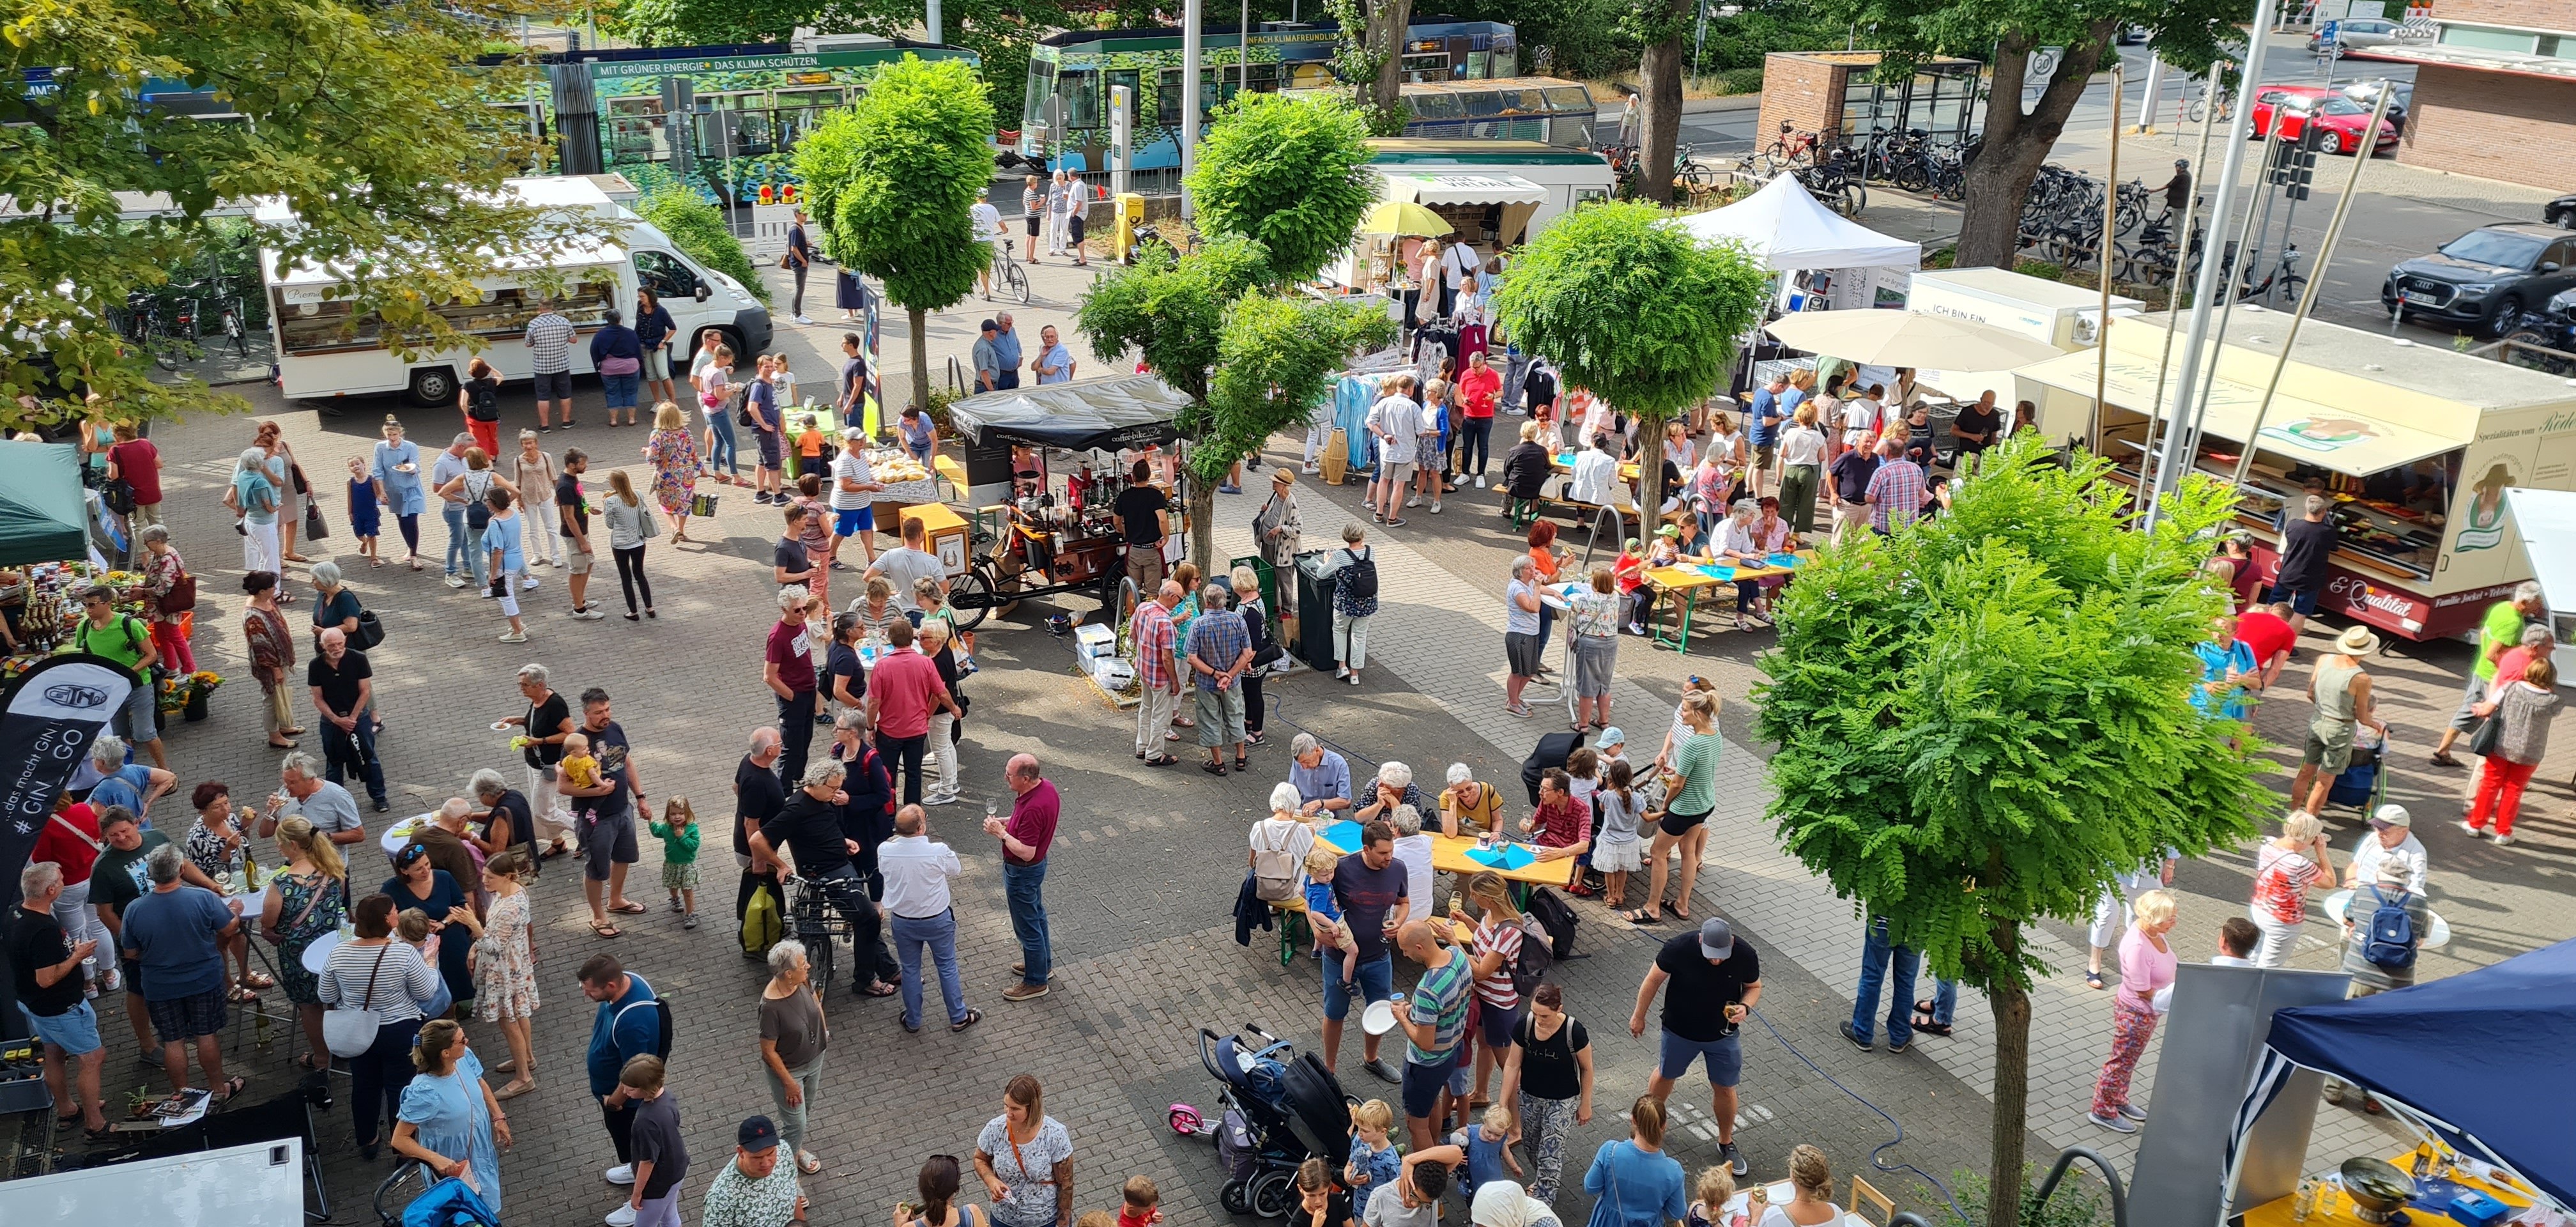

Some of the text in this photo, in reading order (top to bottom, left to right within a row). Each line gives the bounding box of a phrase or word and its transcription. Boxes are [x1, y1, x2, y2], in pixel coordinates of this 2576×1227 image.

[1246, 35, 1273, 44] INFACH
[600, 66, 618, 75] MIT
[621, 63, 662, 74] GRÜNER
[715, 61, 734, 70] DAS
[737, 59, 766, 68] KLIMA
[769, 57, 820, 67] SCHÜTZEN.
[2037, 58, 2050, 70] 30
[834, 73, 852, 82] 9858
[1933, 304, 1949, 316] ICH
[1952, 309, 1967, 320] BIN
[1112, 431, 1146, 442] coffee-bike
[2478, 429, 2520, 444] Spezialitäten
[2329, 576, 2412, 617] & Qualität
[2435, 595, 2461, 608] Familie
[16, 753, 41, 789] macht
[34, 728, 58, 752] GIN
[22, 780, 53, 814] GIN
[53, 729, 83, 760] GO
